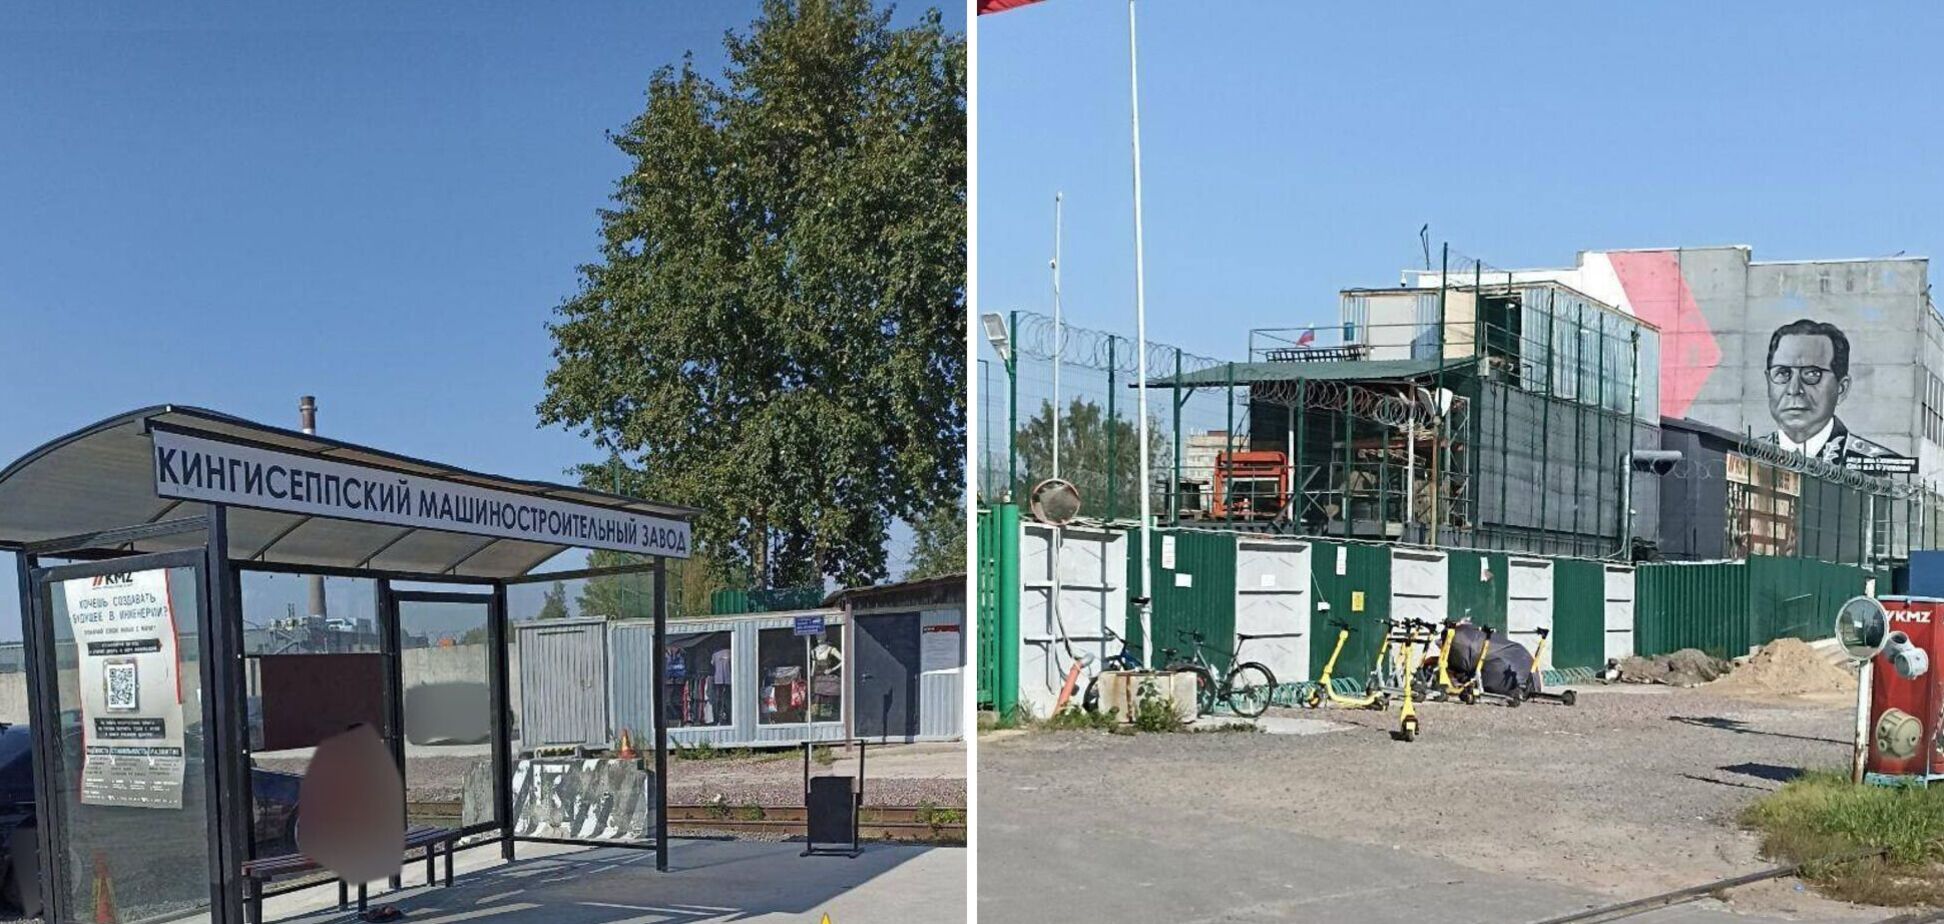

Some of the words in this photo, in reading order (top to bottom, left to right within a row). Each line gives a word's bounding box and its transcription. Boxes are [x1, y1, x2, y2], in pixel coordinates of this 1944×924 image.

[158, 446, 411, 516] КИНГИСЕППСКИЙ
[418, 490, 638, 545] МАШИНОСТРОИТЕЛЬНЫЙ
[642, 524, 687, 554] ЗАВОД
[105, 571, 133, 585] KMZ
[80, 598, 109, 610] ХОЧЕШЬ
[113, 593, 156, 607] СОЗДАВАТЬ
[109, 611, 115, 621] В
[1896, 610, 1931, 623] KMZ
